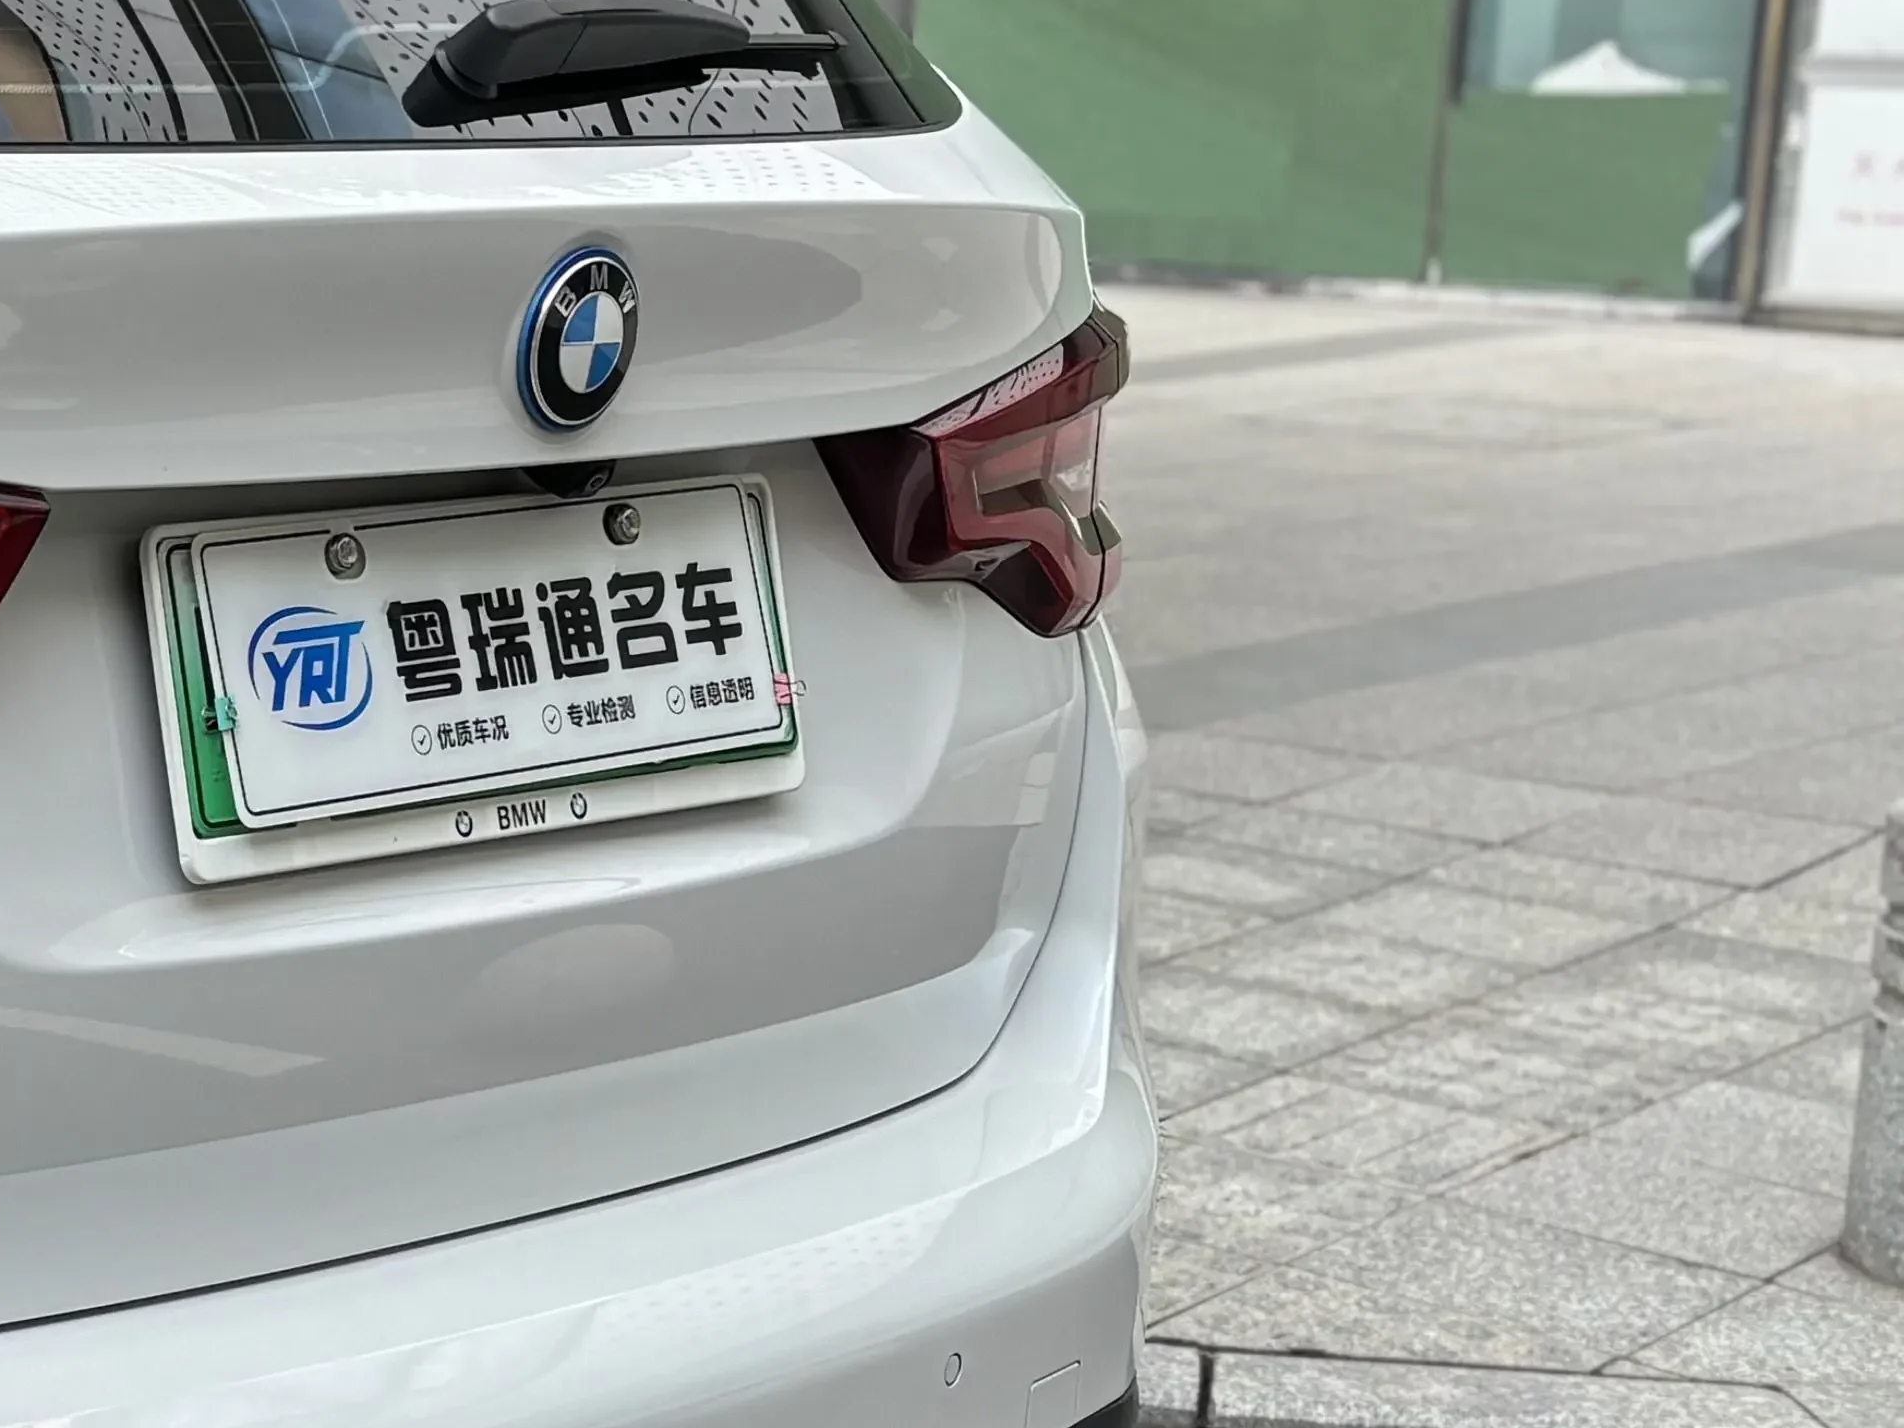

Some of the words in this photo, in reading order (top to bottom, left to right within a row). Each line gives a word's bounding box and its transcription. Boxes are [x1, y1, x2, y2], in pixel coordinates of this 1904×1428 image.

[554, 264, 638, 318] BMW
[386, 561, 744, 702] 粤瑞通名车
[437, 714, 511, 750] 优质车况
[566, 694, 637, 729] 专业检测
[690, 676, 755, 710] 信息透明
[496, 799, 546, 831] BMW
